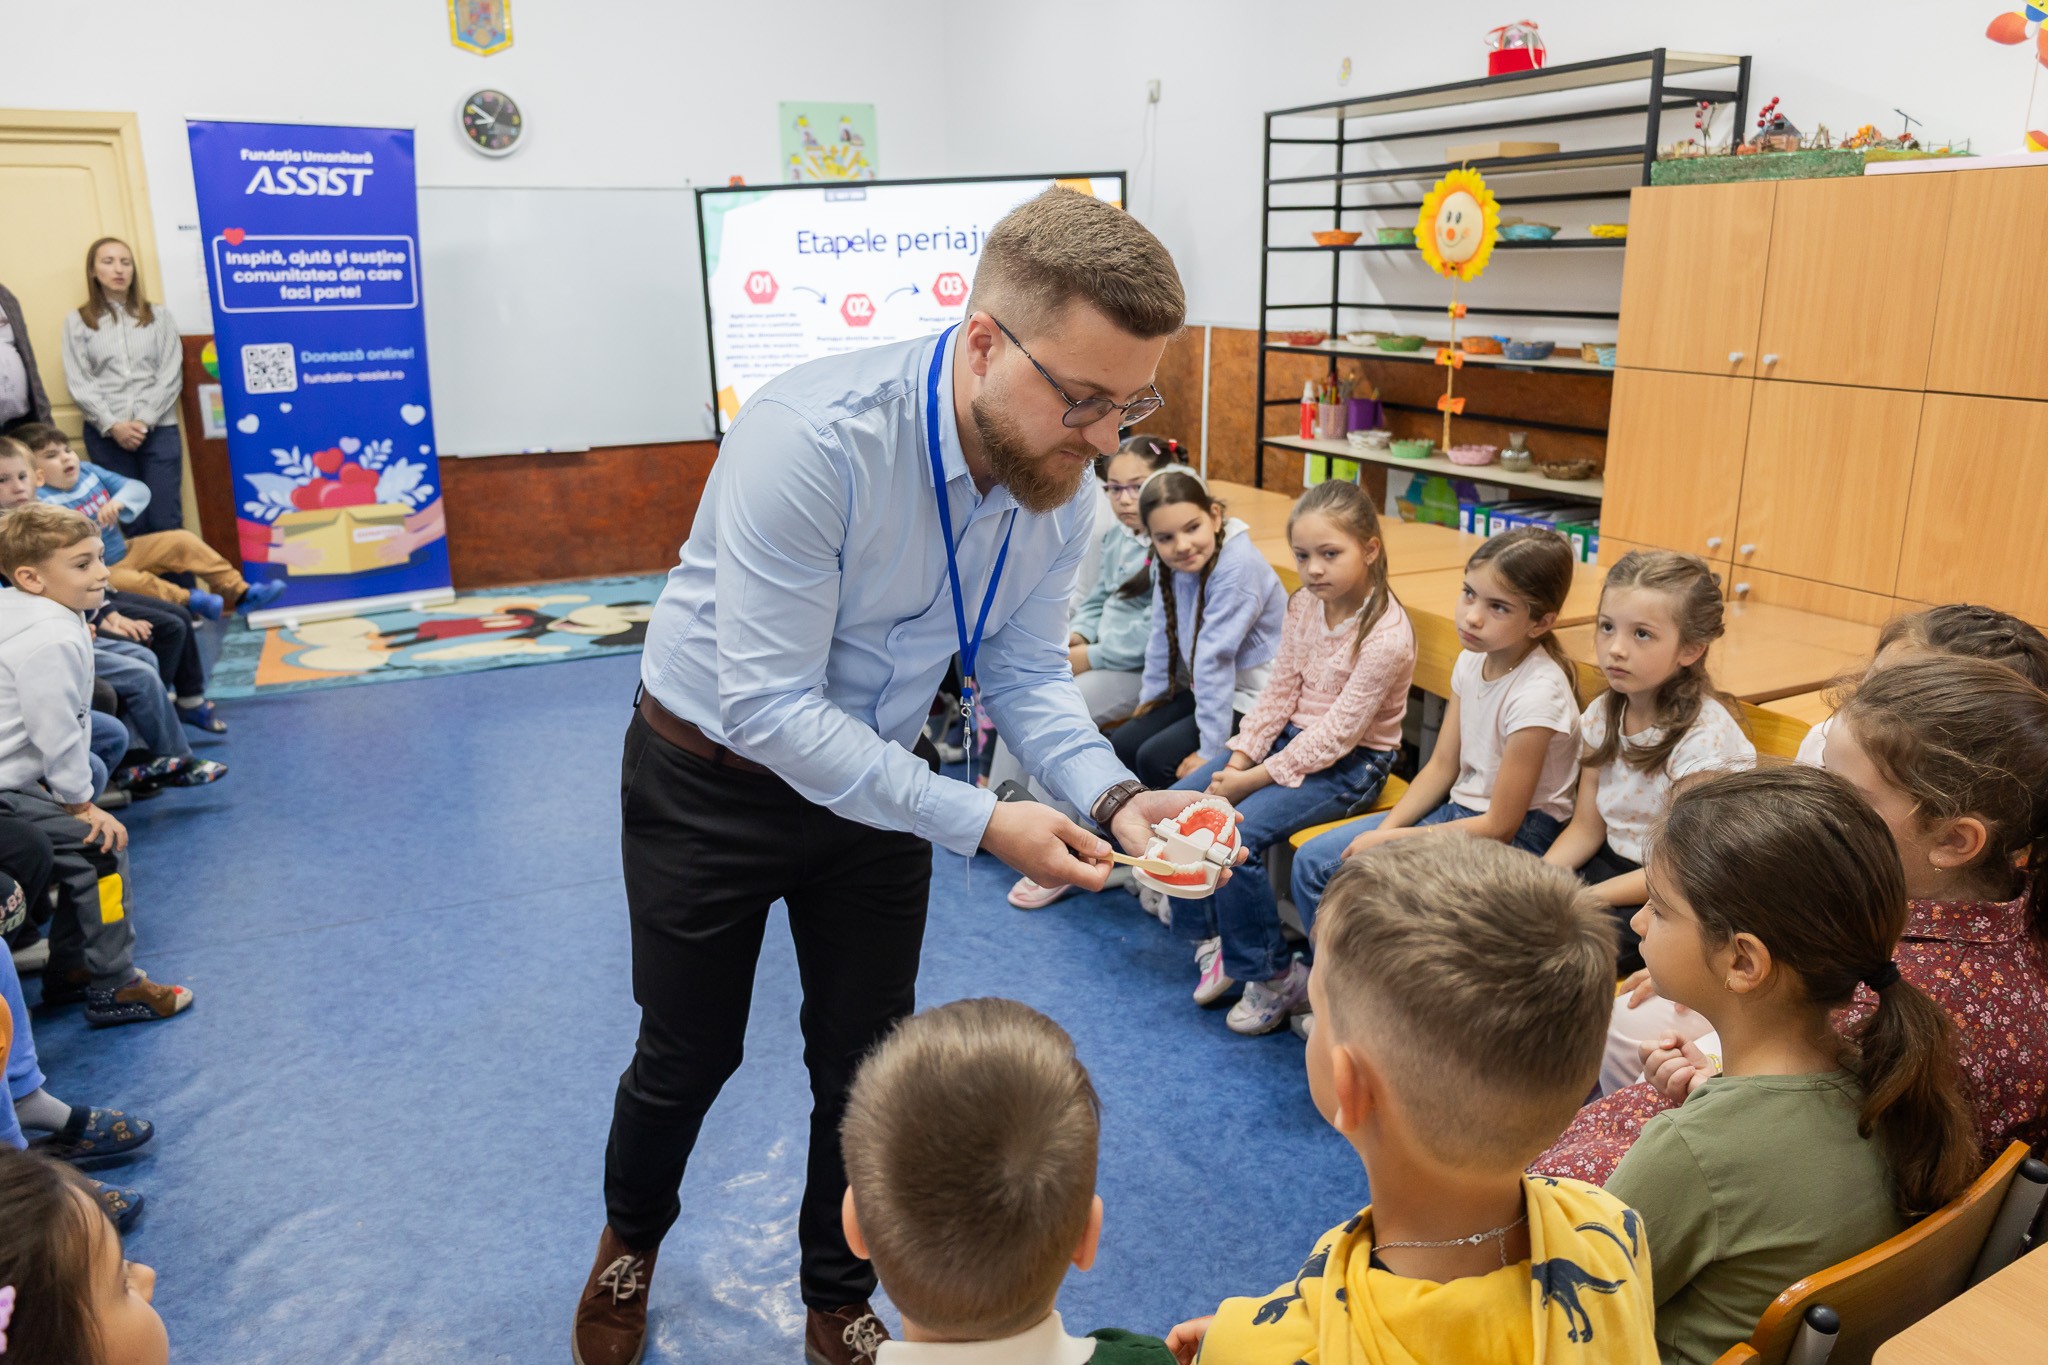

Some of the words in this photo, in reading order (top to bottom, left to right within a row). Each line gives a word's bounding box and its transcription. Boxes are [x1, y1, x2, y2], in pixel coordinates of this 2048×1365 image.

[240, 148, 301, 165] Fundația
[302, 149, 373, 164] Umanitară
[245, 165, 374, 196] ASSIST
[797, 228, 887, 260] Etapele
[897, 224, 987, 258] periaj
[225, 250, 287, 269] Inspiră,
[288, 249, 332, 268] ajută
[334, 249, 348, 267] și
[350, 249, 406, 267] susține
[232, 267, 338, 283] comunitatea
[339, 266, 366, 281] din
[367, 269, 403, 281] care
[750, 274, 772, 295] 01
[279, 284, 311, 300] faci
[313, 285, 362, 303] parte!
[938, 276, 963, 297] 03
[846, 296, 871, 317] 02
[300, 348, 365, 364] Donează
[366, 347, 415, 361] online!
